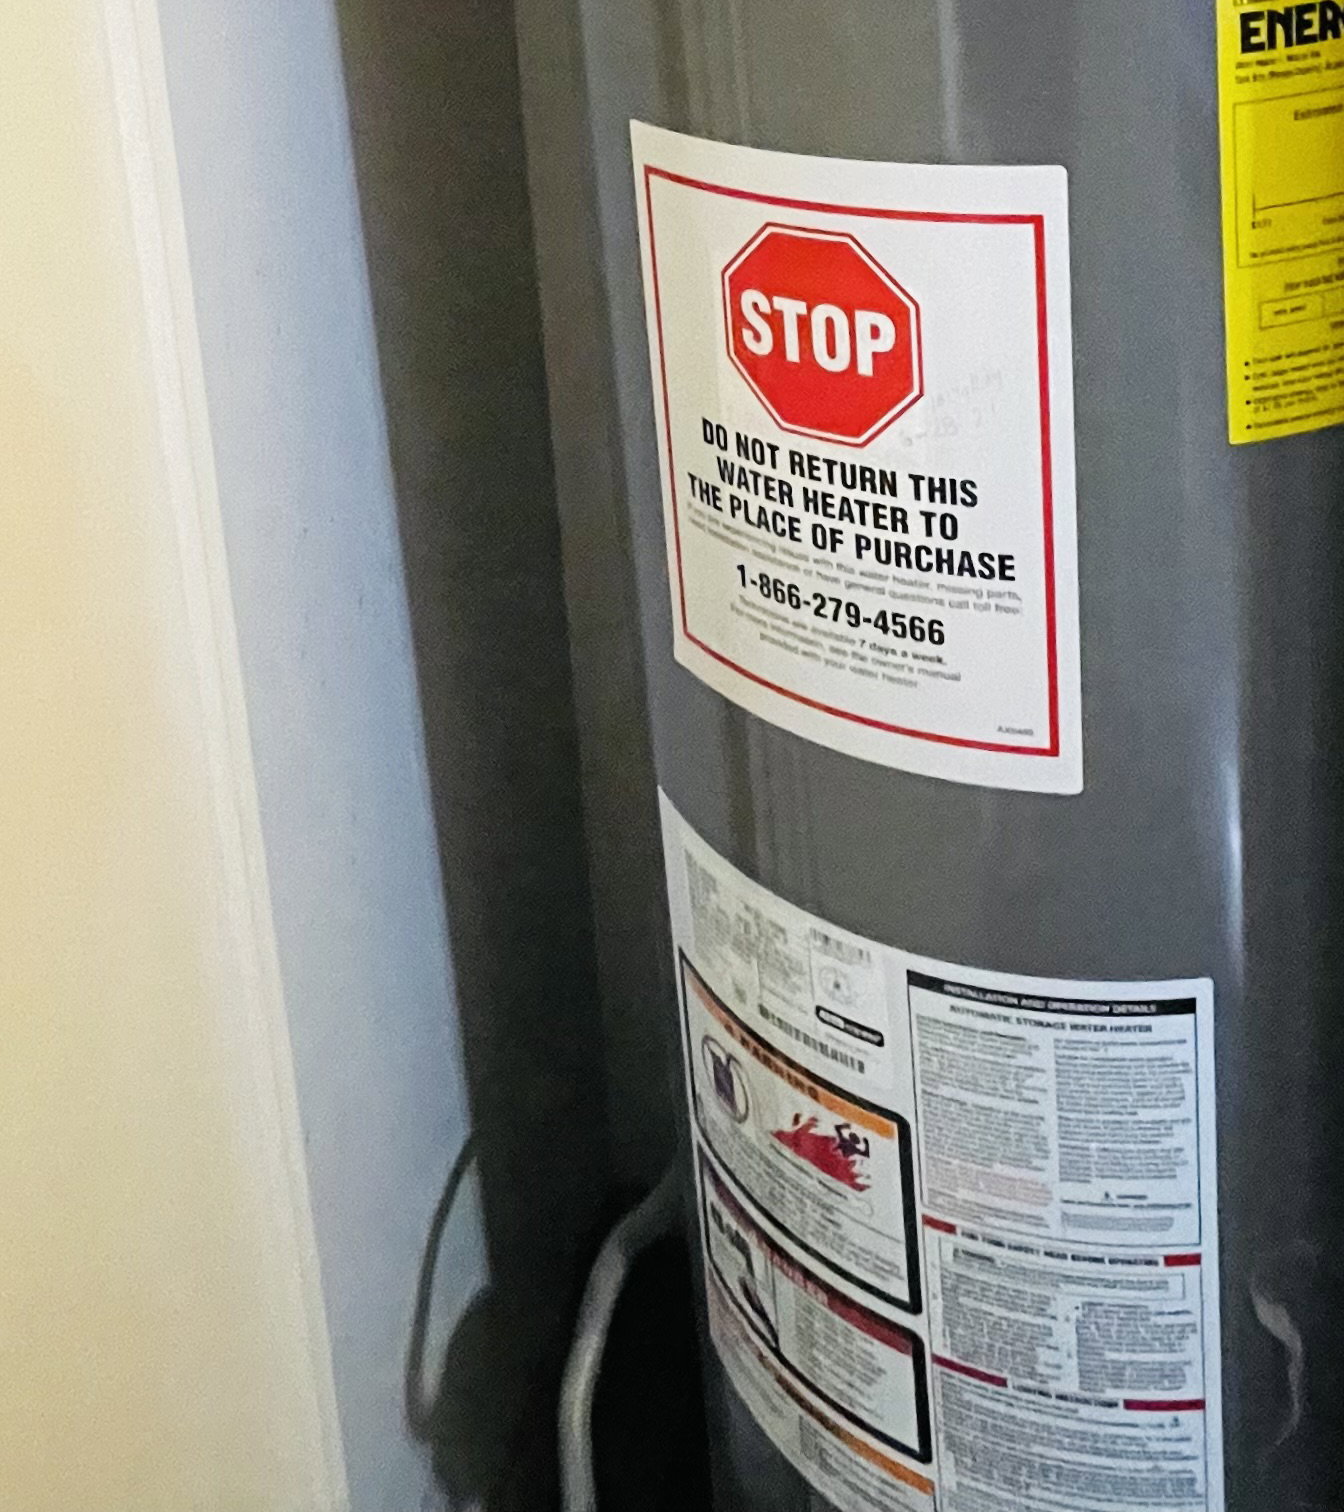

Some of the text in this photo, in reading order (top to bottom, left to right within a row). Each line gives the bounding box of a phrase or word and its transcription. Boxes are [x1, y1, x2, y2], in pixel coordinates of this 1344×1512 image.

[740, 288, 896, 377] STOP
[701, 416, 978, 508] DO NOT RETURN THIS
[716, 455, 795, 508] WATER
[802, 485, 910, 535] HEATER
[919, 510, 959, 541] TO
[687, 471, 724, 513] THE
[729, 493, 803, 543] PLACE
[811, 522, 845, 554] OF
[855, 533, 1017, 582] PURCHASE
[736, 563, 945, 646] 1-866-279-4566
[869, 642, 898, 657] days
